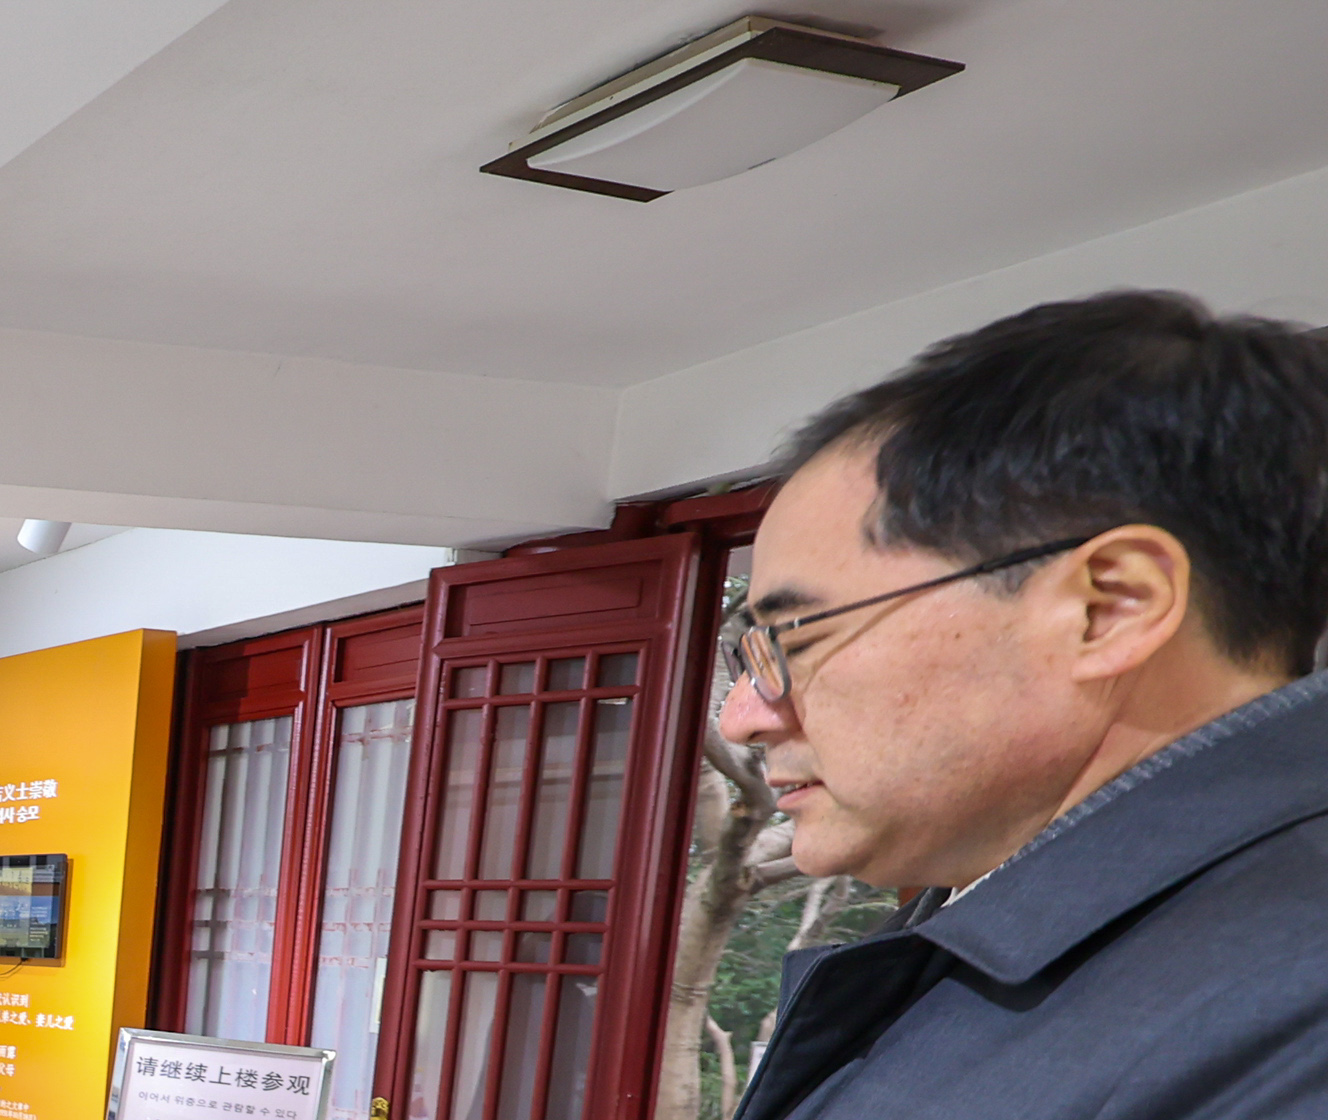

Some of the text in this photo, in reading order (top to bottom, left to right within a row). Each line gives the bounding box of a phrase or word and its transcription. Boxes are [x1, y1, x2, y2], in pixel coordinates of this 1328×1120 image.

[16, 805, 41, 823] 숭모
[136, 1056, 311, 1096] 请继续上楼参观
[138, 1091, 171, 1104] 이어서
[222, 1101, 256, 1115] 관람할
[259, 1107, 271, 1116] 수
[275, 1108, 298, 1120] 있다
